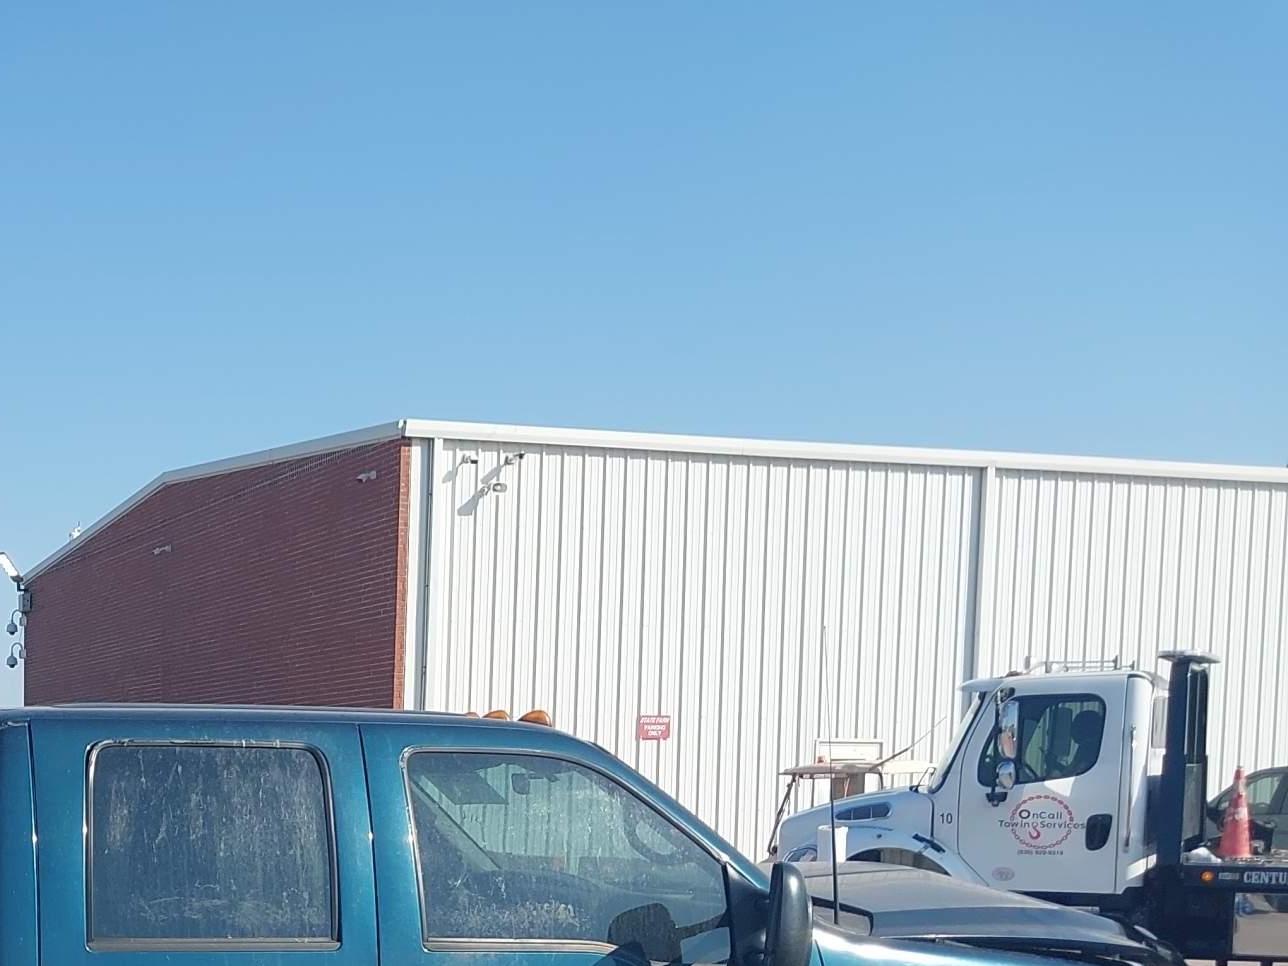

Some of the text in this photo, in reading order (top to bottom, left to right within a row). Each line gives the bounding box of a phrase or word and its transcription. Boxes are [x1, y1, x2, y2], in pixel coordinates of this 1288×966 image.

[940, 812, 953, 824] 10
[1018, 809, 1063, 819] OnCall
[1040, 820, 1086, 829] Services
[1243, 871, 1288, 884] CENTU
